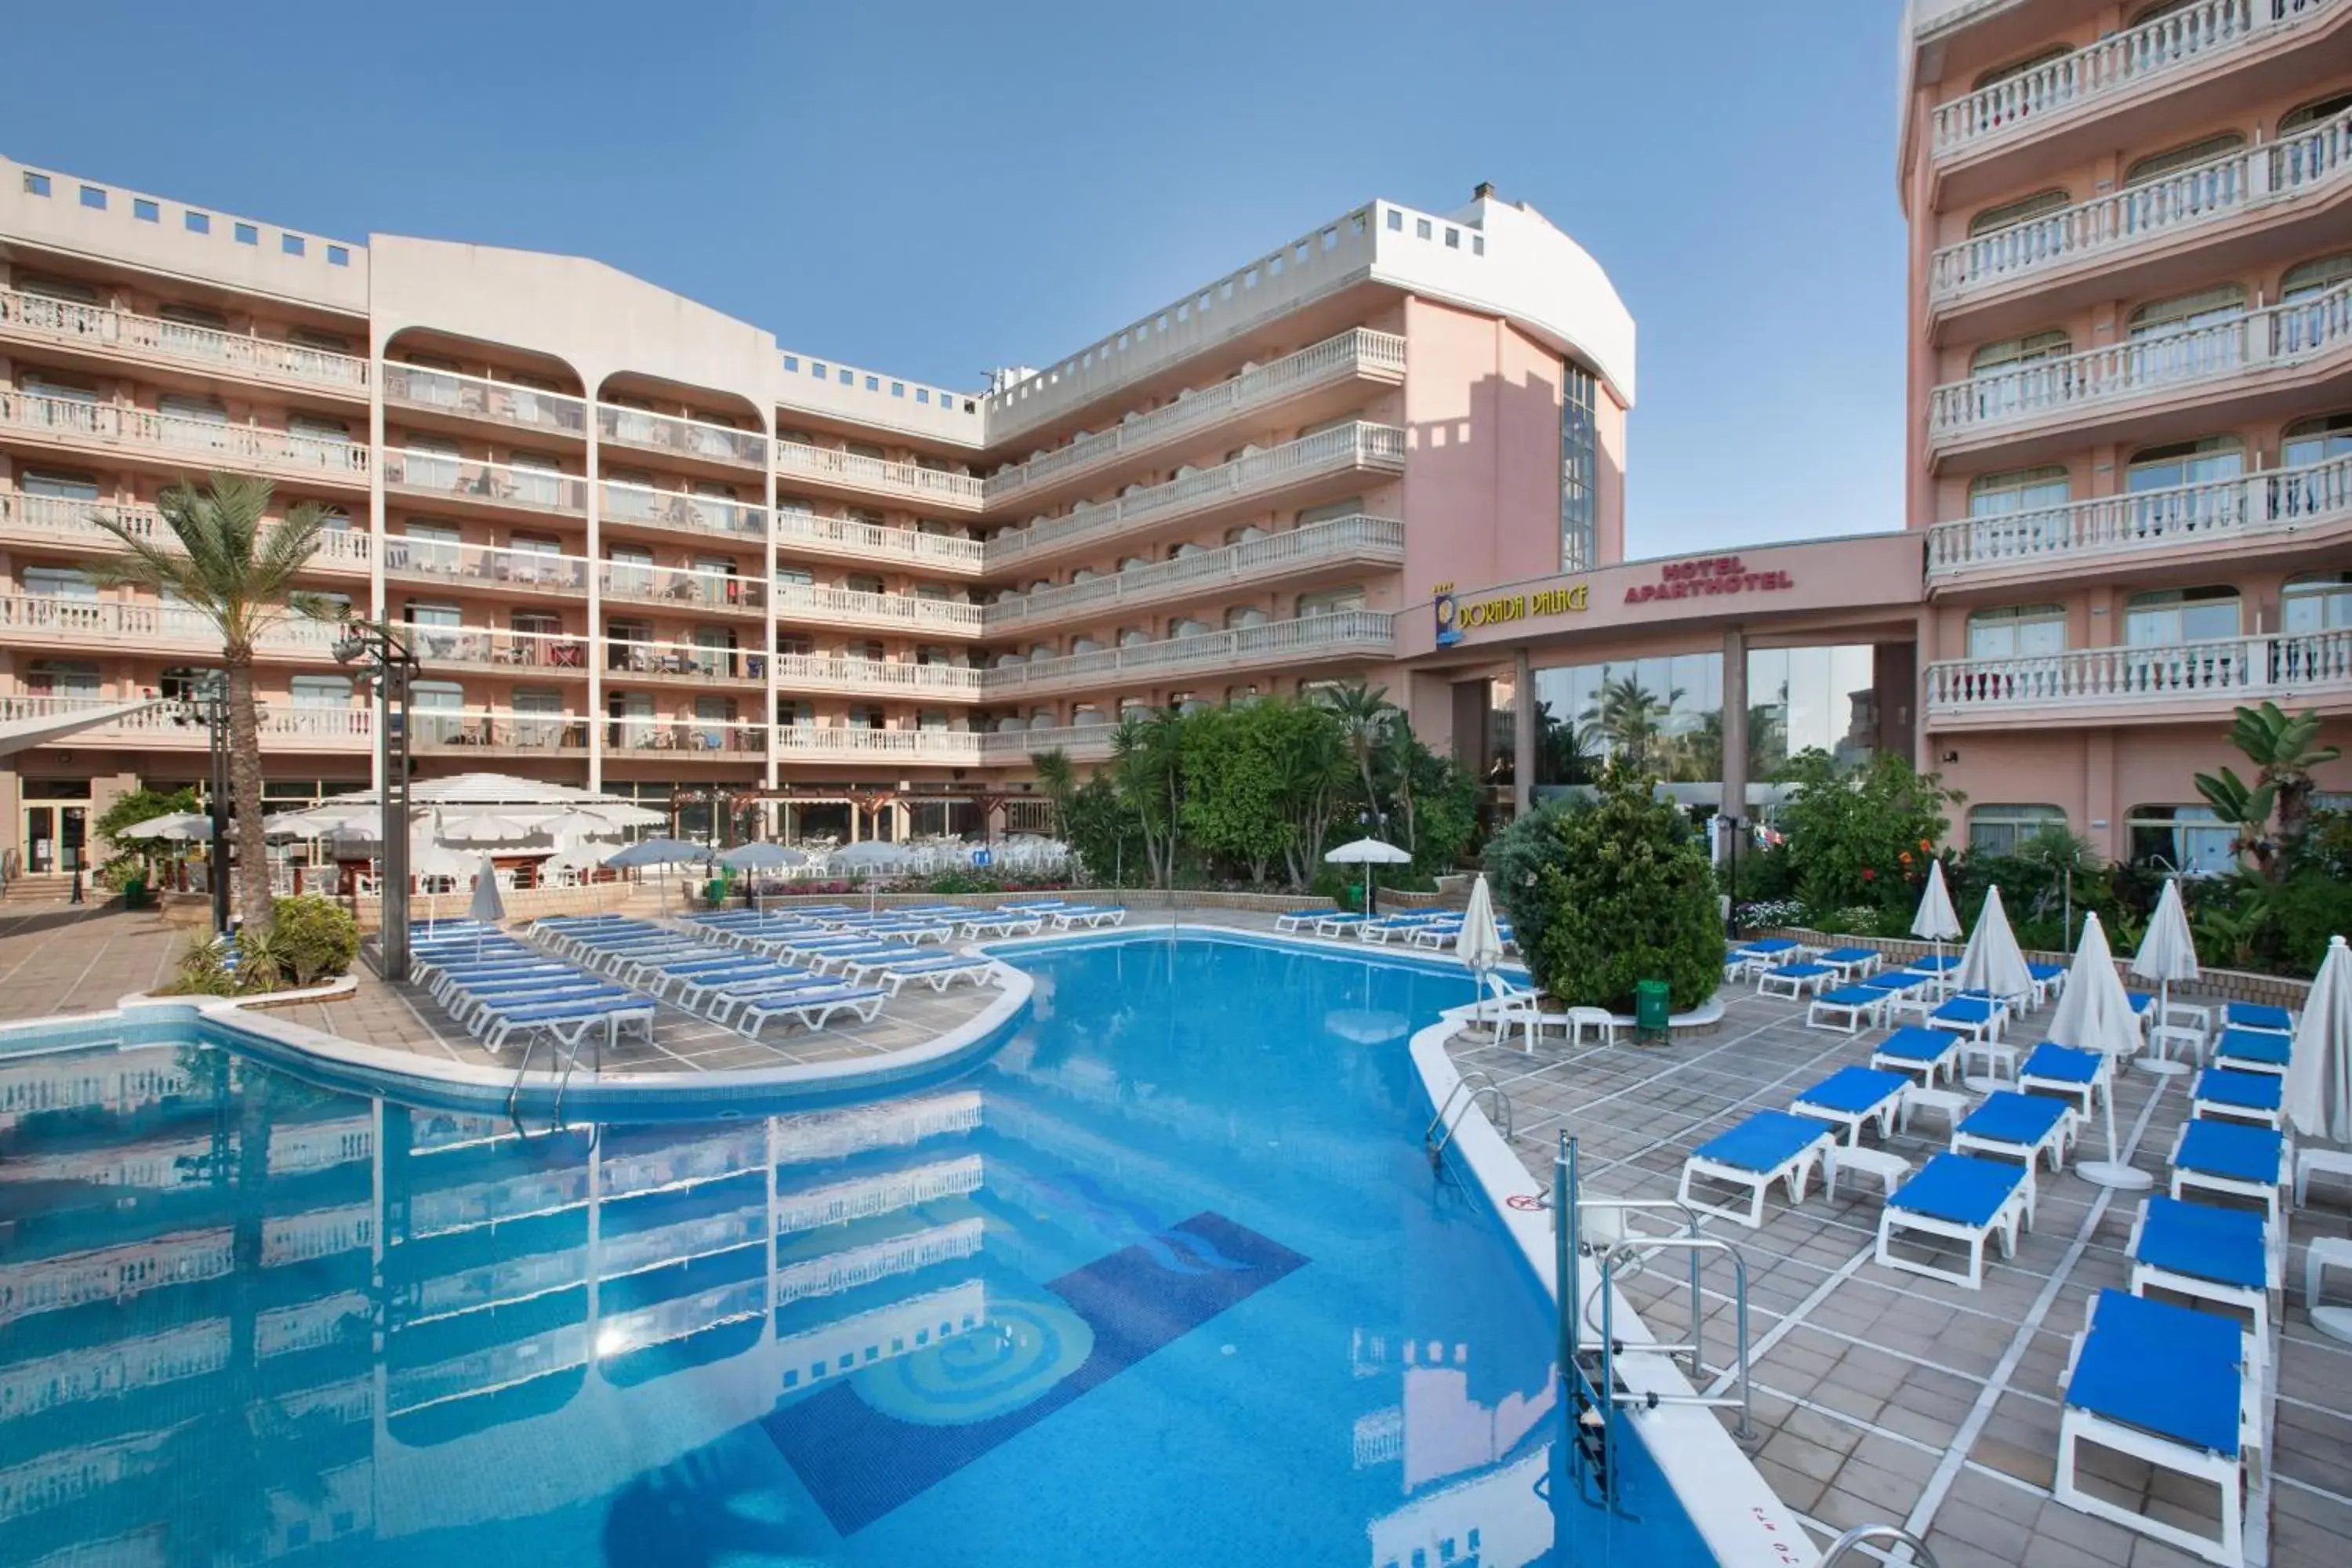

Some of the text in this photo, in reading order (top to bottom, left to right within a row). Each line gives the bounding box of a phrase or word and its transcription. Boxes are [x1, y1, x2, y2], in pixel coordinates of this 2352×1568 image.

[1662, 555, 1746, 582] HOTEL
[1624, 570, 1794, 604] APARTHOTEL
[1459, 585, 1588, 629] DORADA PALACE
